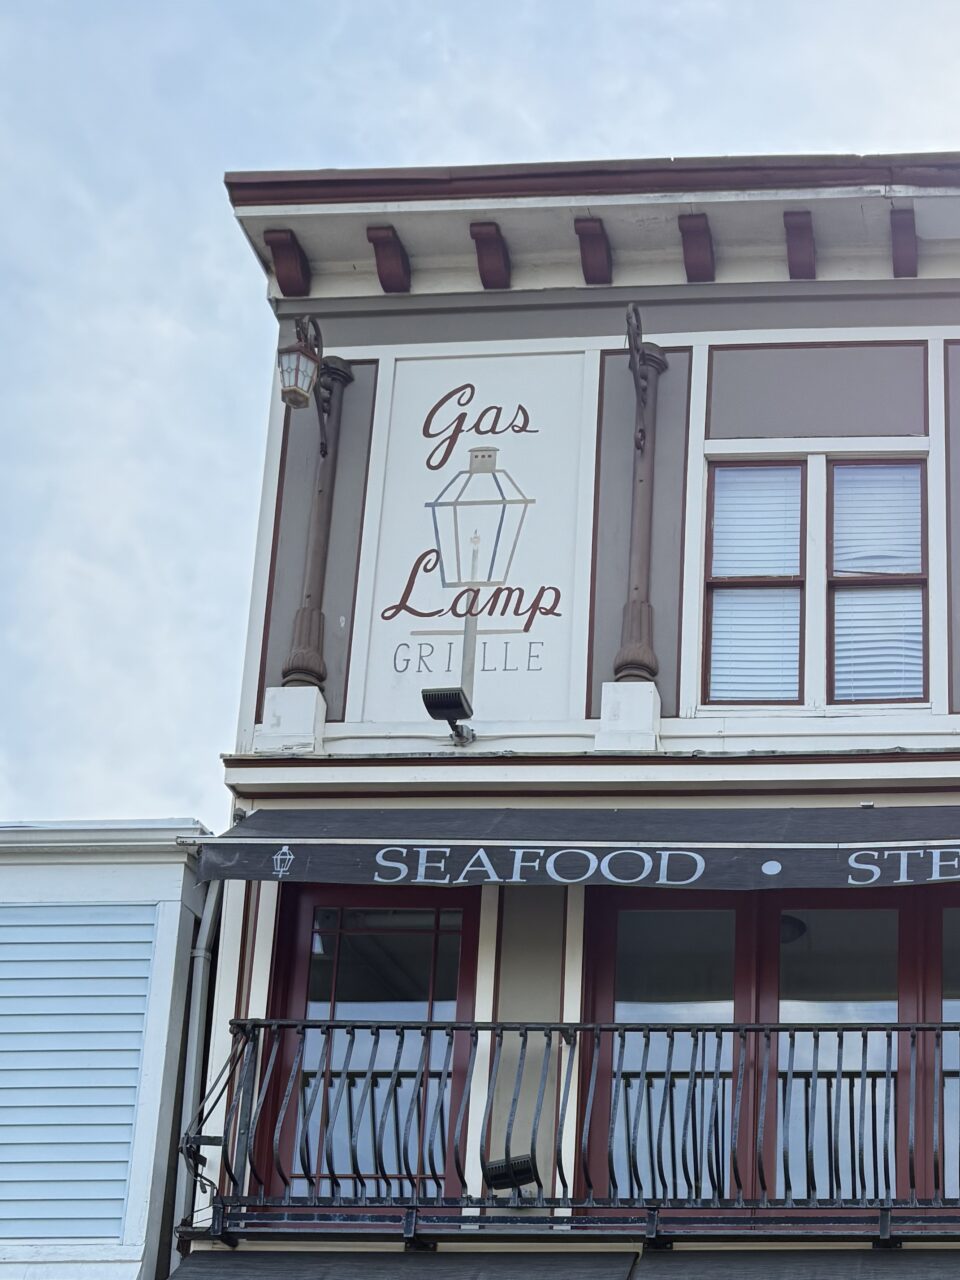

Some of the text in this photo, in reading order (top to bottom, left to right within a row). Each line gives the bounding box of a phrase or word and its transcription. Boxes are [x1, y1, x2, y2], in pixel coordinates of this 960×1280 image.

[422, 383, 539, 470] Gas
[381, 549, 562, 633] Lamp
[393, 641, 544, 673] GRILLE
[373, 847, 706, 886] SEAFOOD
